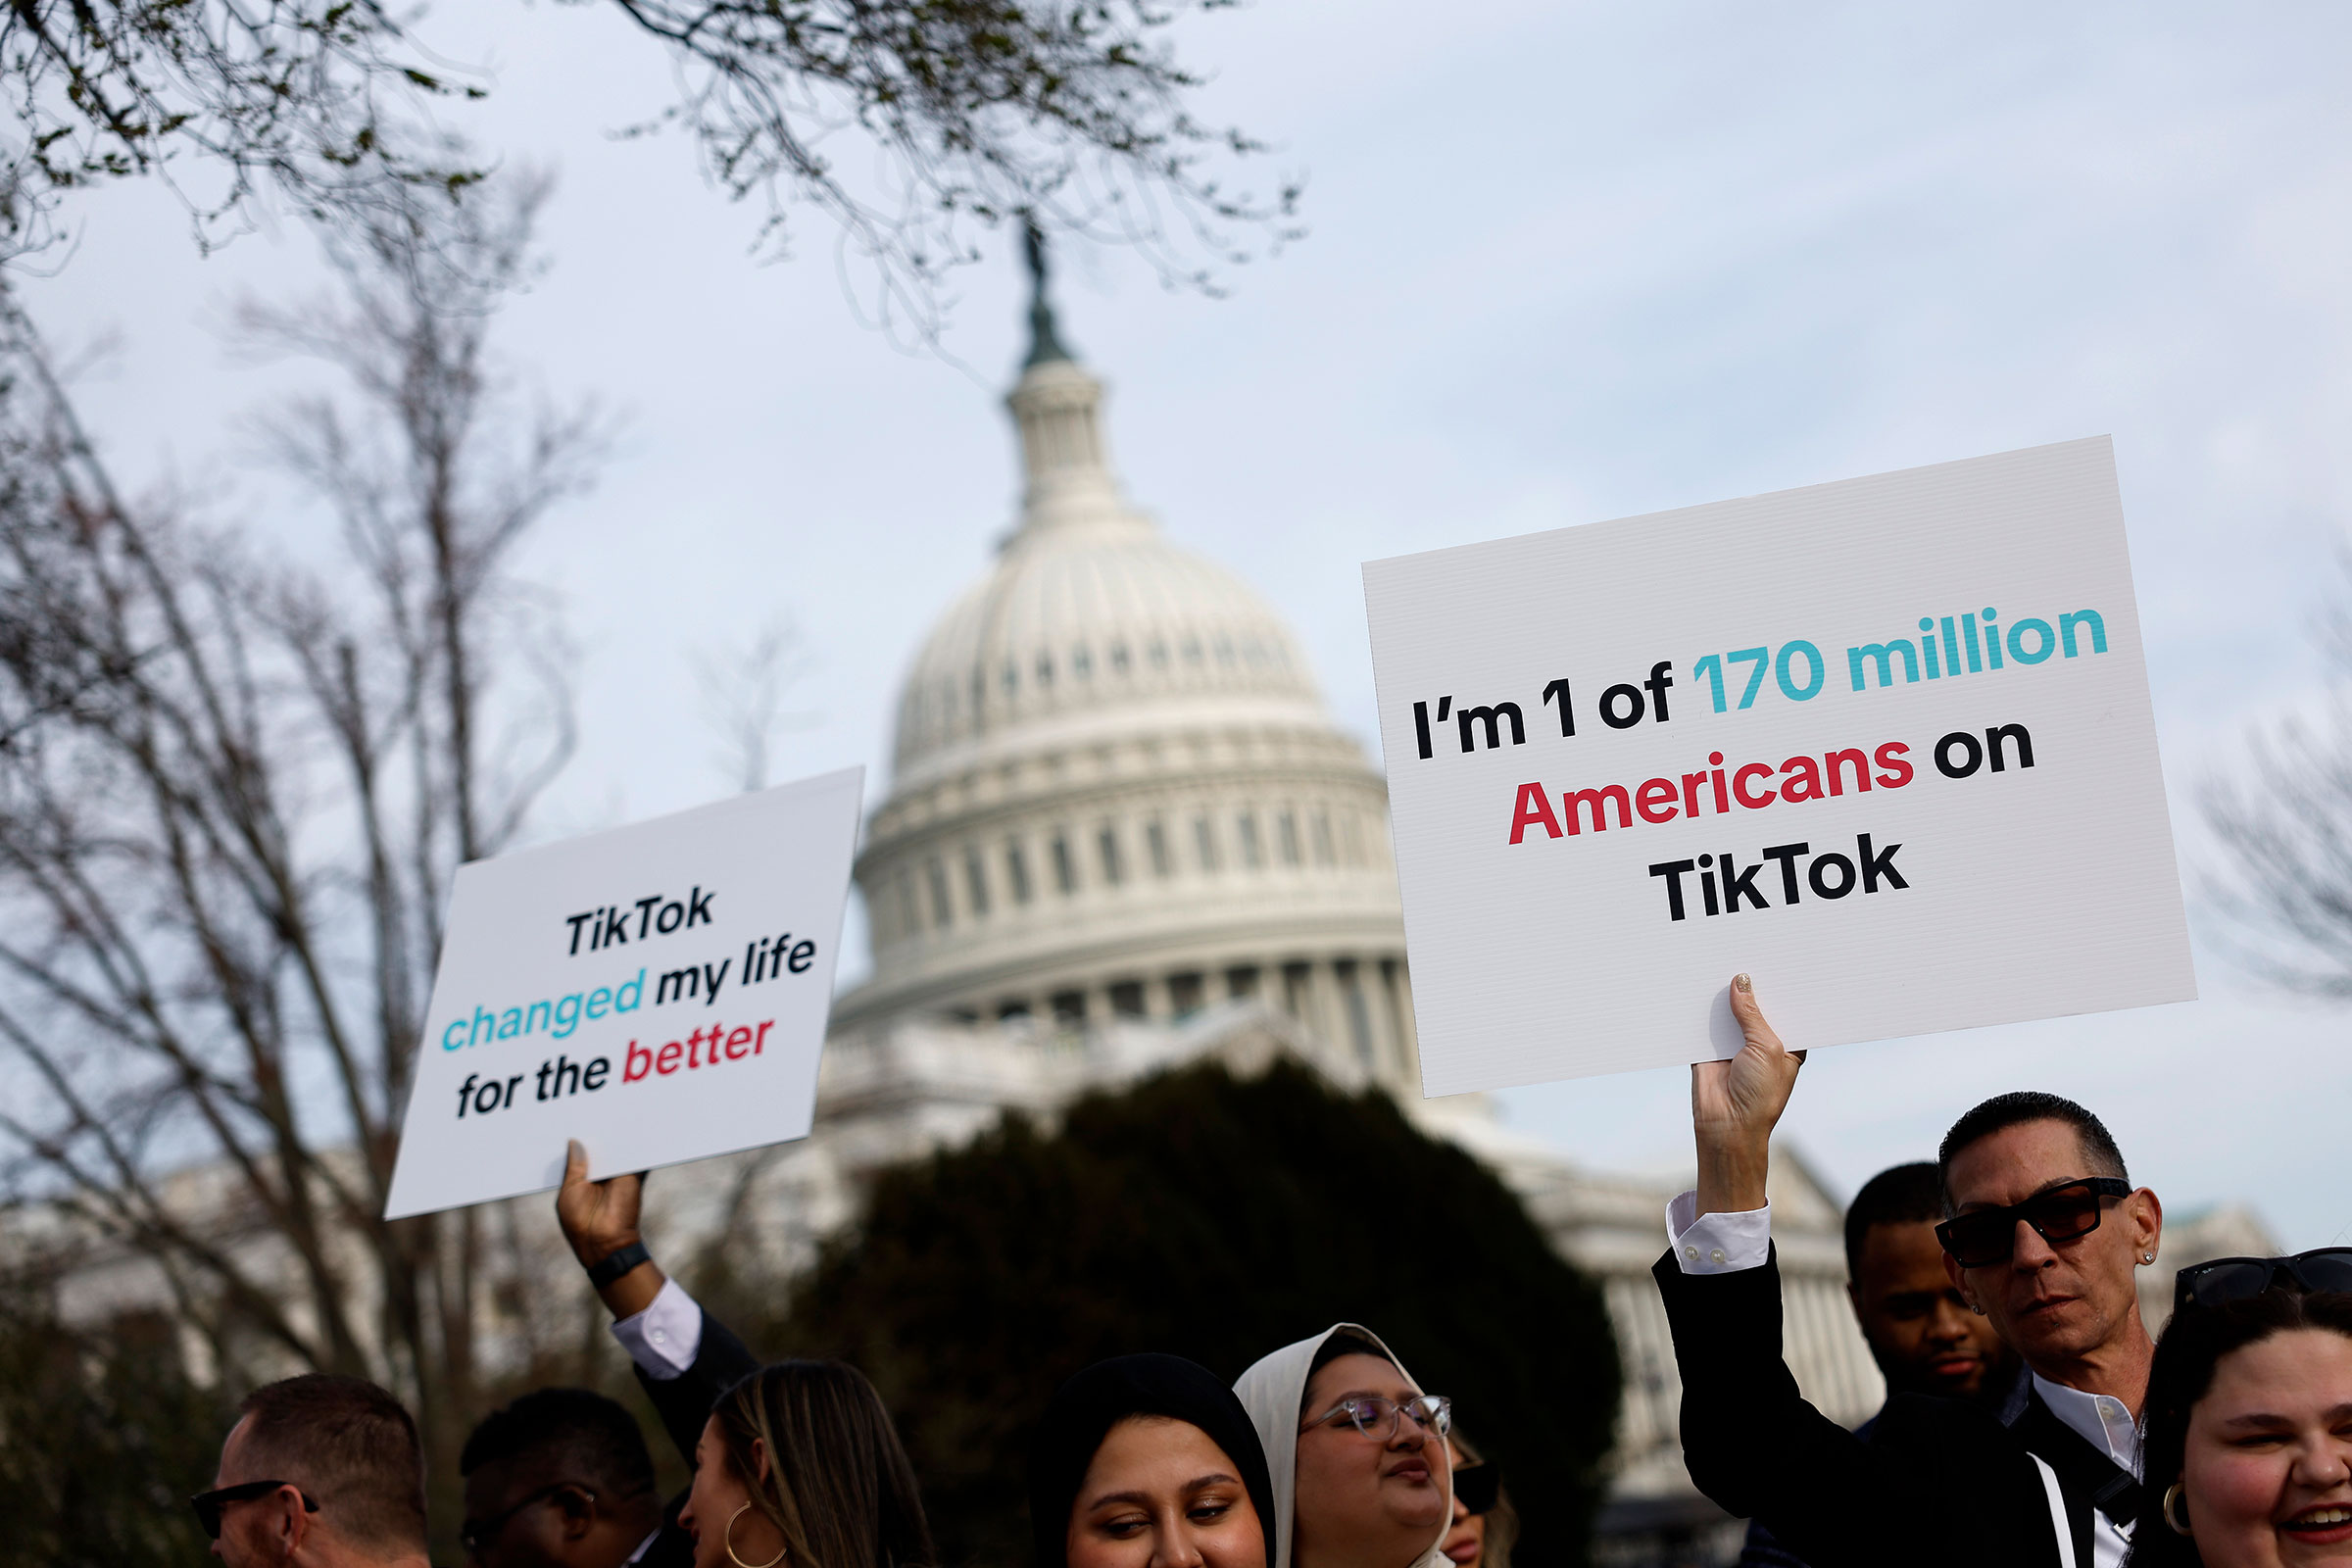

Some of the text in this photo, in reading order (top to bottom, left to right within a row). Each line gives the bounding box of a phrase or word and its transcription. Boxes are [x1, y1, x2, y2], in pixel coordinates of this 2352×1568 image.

[1412, 607, 2108, 760] I'm 1 of 170 million
[1508, 722, 2035, 846] Americans on
[564, 885, 715, 957] TikTok
[1647, 832, 1910, 922] TikTok
[441, 932, 816, 1053] changed my life
[457, 1019, 775, 1120] for the better
